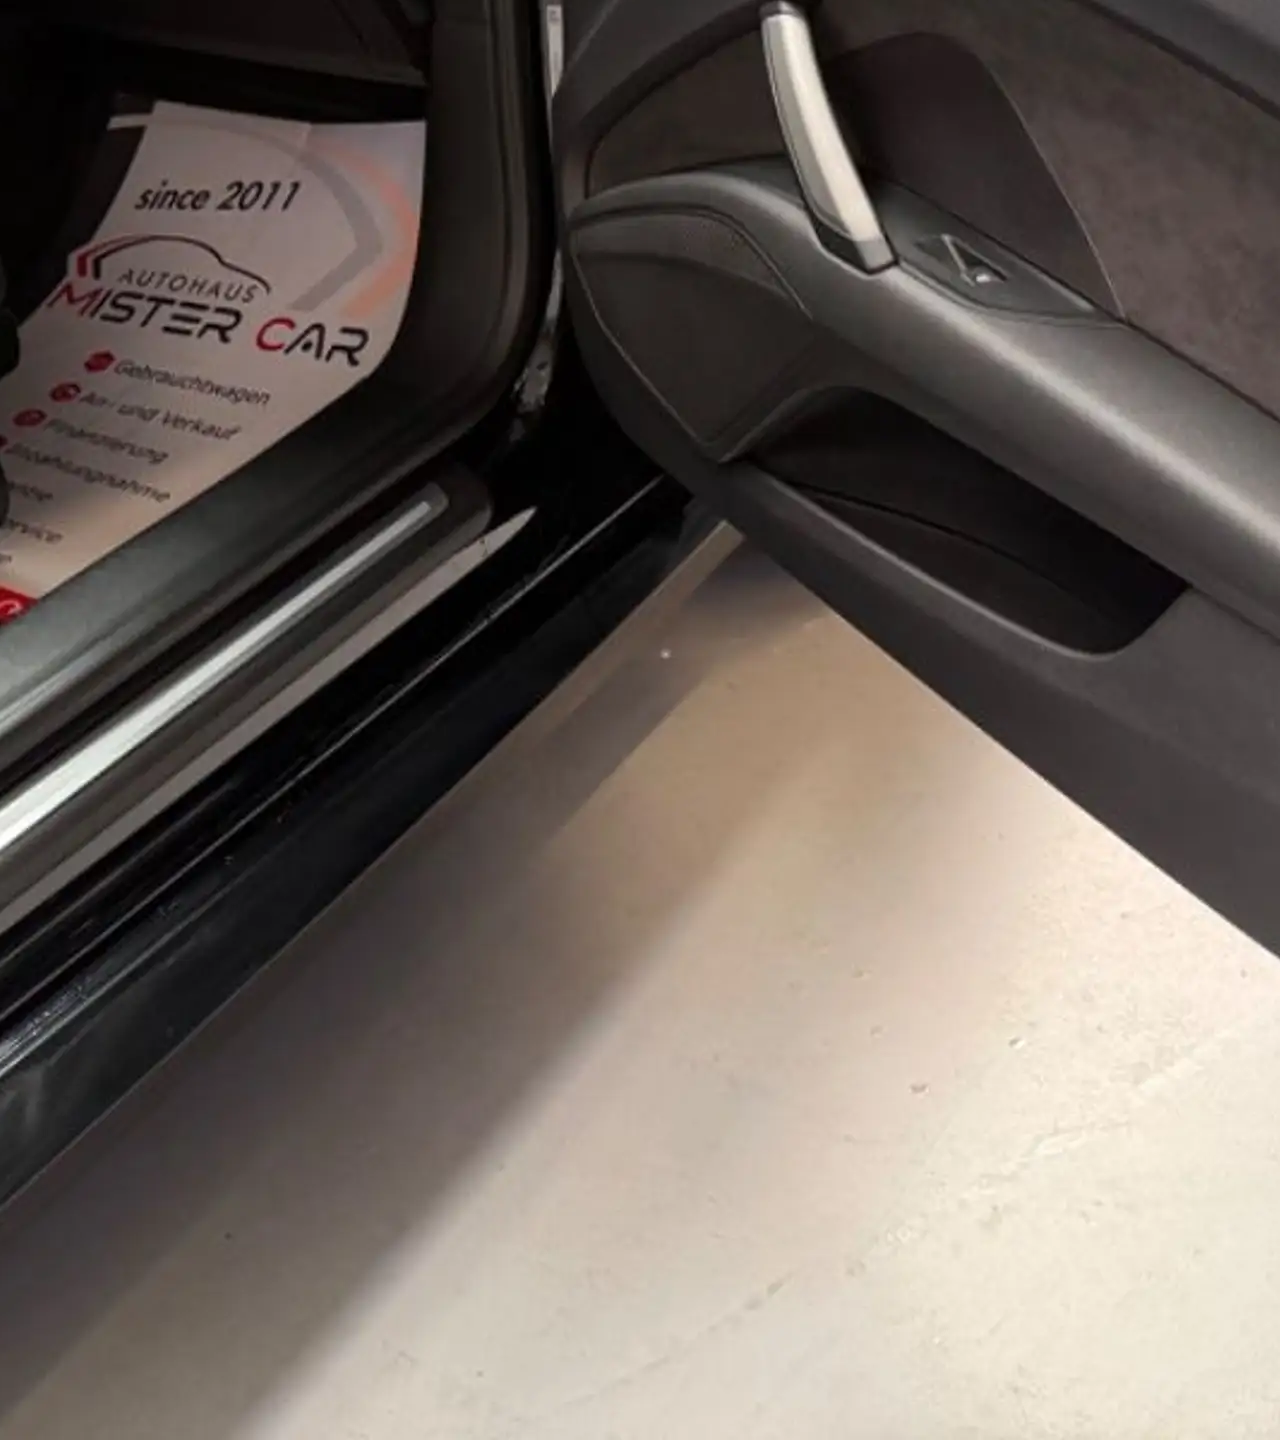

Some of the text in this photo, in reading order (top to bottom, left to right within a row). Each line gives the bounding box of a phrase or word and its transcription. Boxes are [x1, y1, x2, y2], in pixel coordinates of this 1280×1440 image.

[134, 180, 301, 211] since 2011
[118, 268, 258, 304] AUTOHAUS
[47, 283, 369, 367] MISTER CAR
[114, 360, 271, 407] Gebrauchtwagen
[162, 410, 242, 441] Verkauf
